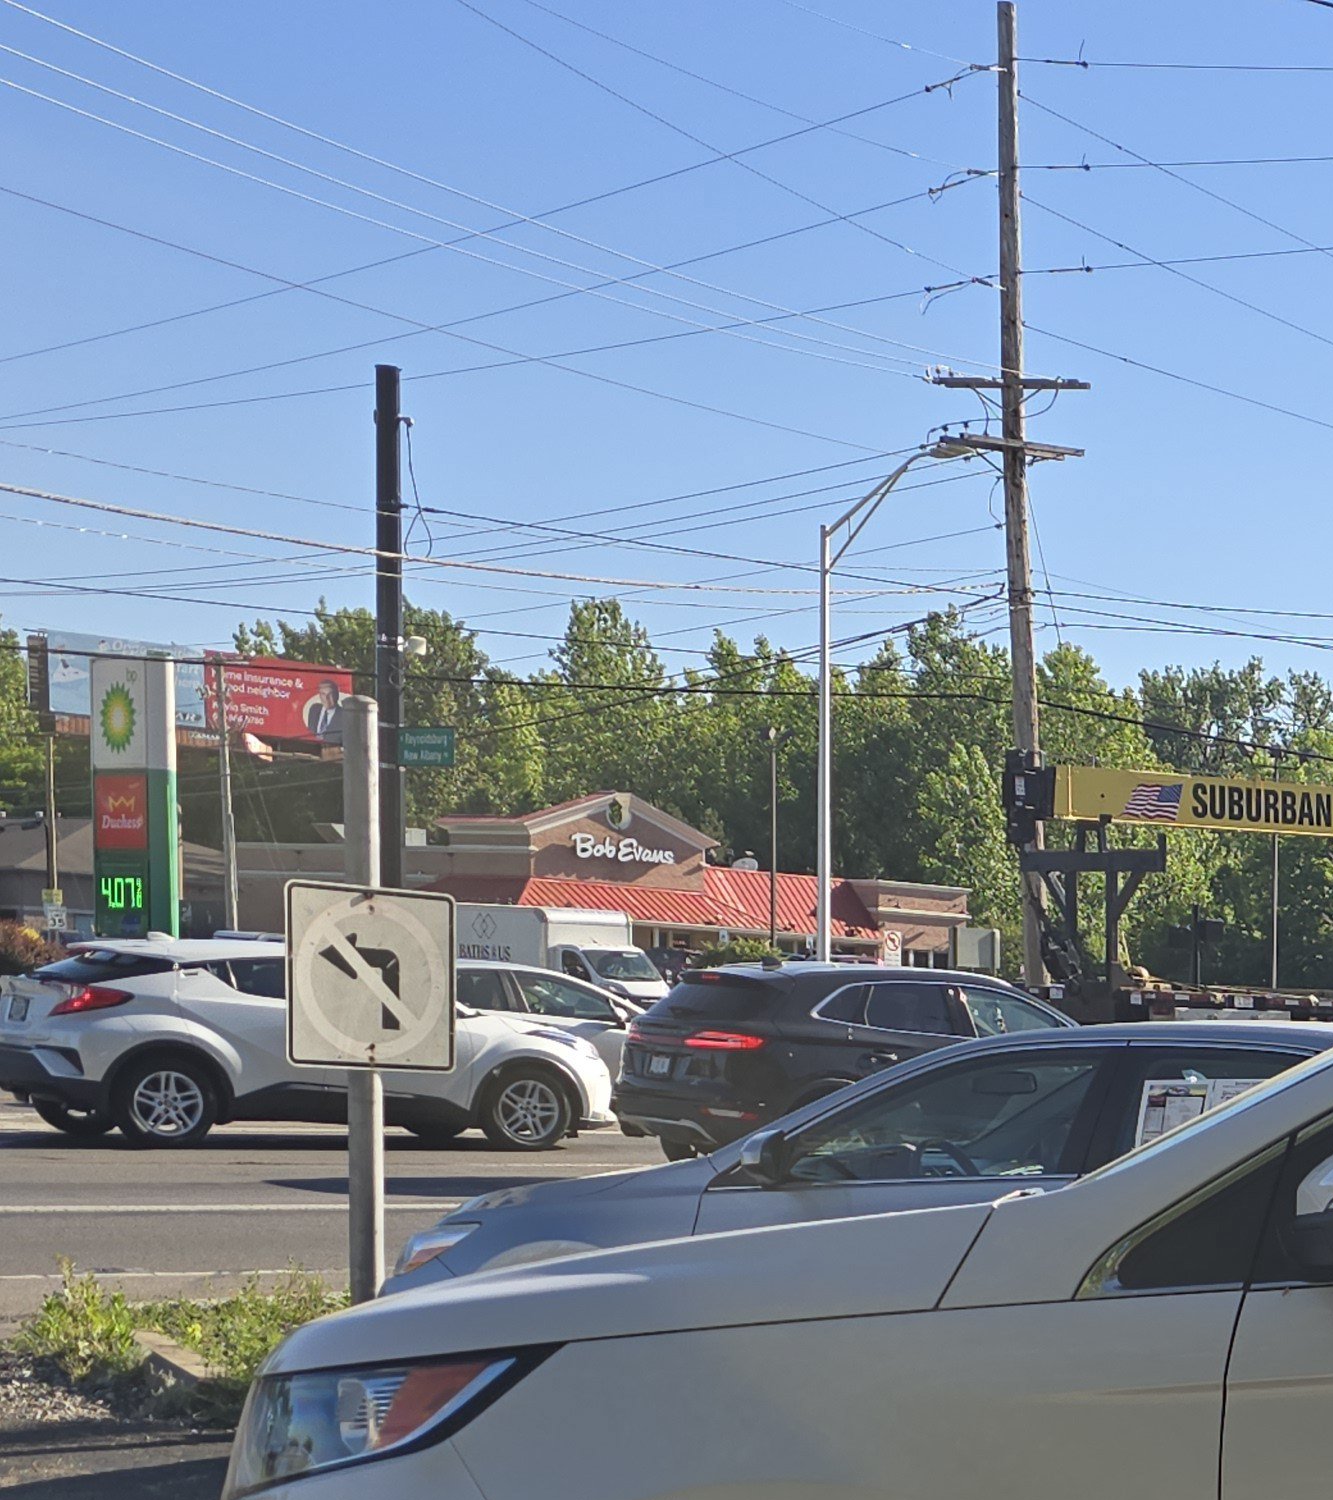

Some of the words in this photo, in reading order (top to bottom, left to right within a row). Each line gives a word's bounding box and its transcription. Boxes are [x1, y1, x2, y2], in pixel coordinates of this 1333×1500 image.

[125, 667, 138, 685] bp
[1192, 782, 1332, 828] SUBURBAN
[102, 814, 143, 829] Duchess
[571, 832, 616, 858] Bob
[618, 838, 675, 864] Evans
